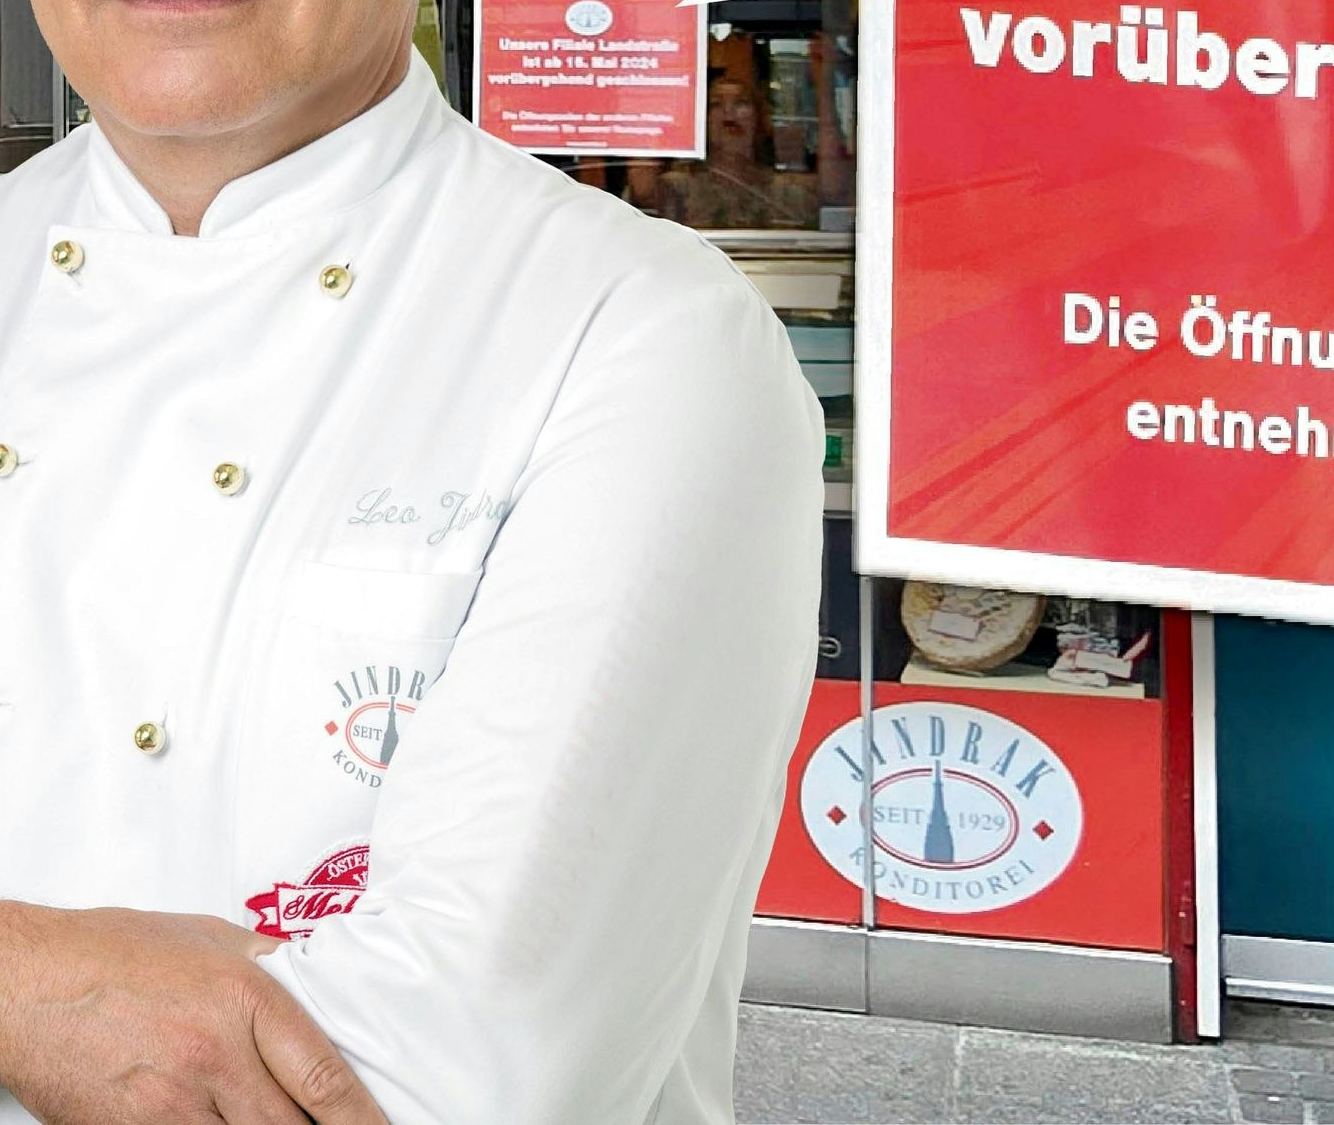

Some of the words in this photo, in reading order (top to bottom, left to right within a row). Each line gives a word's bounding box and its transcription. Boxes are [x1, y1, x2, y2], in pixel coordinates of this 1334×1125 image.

[1063, 293, 1158, 351] Die
[348, 487, 420, 524] Leo
[330, 665, 426, 709] JINDR
[352, 723, 383, 742] SEIT
[834, 715, 1057, 800] JINDRAK
[873, 807, 924, 826] SEIT
[958, 812, 1006, 832] 1929
[849, 846, 1035, 902] KONDITOREI
